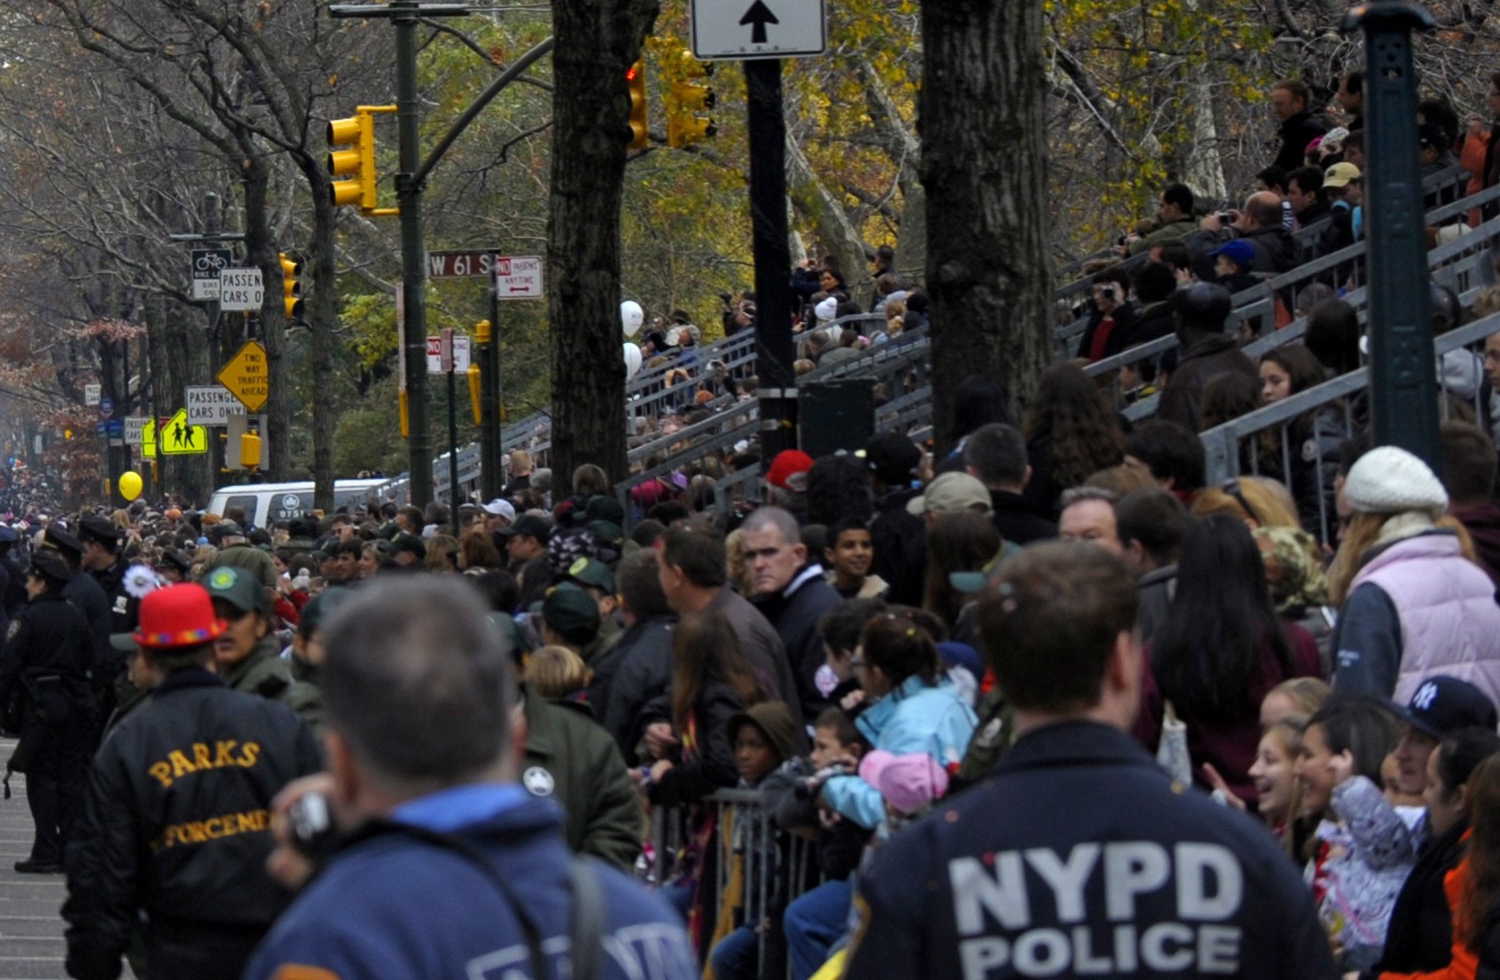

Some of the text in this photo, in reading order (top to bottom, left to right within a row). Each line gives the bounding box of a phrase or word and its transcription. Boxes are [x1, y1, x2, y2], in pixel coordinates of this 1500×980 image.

[431, 256, 446, 275] W
[453, 255, 471, 275] 61
[497, 260, 509, 274] NO
[223, 274, 261, 286] PASSEN
[223, 291, 248, 303] CARS
[245, 354, 260, 362] TWO
[246, 365, 260, 373] WAY
[238, 375, 268, 385] TRAFFIC
[241, 386, 267, 396] AHEAD
[189, 407, 214, 419] CARS
[149, 740, 260, 788] PARKS
[948, 840, 1244, 936] NYPD
[958, 922, 1242, 980] POLICE
